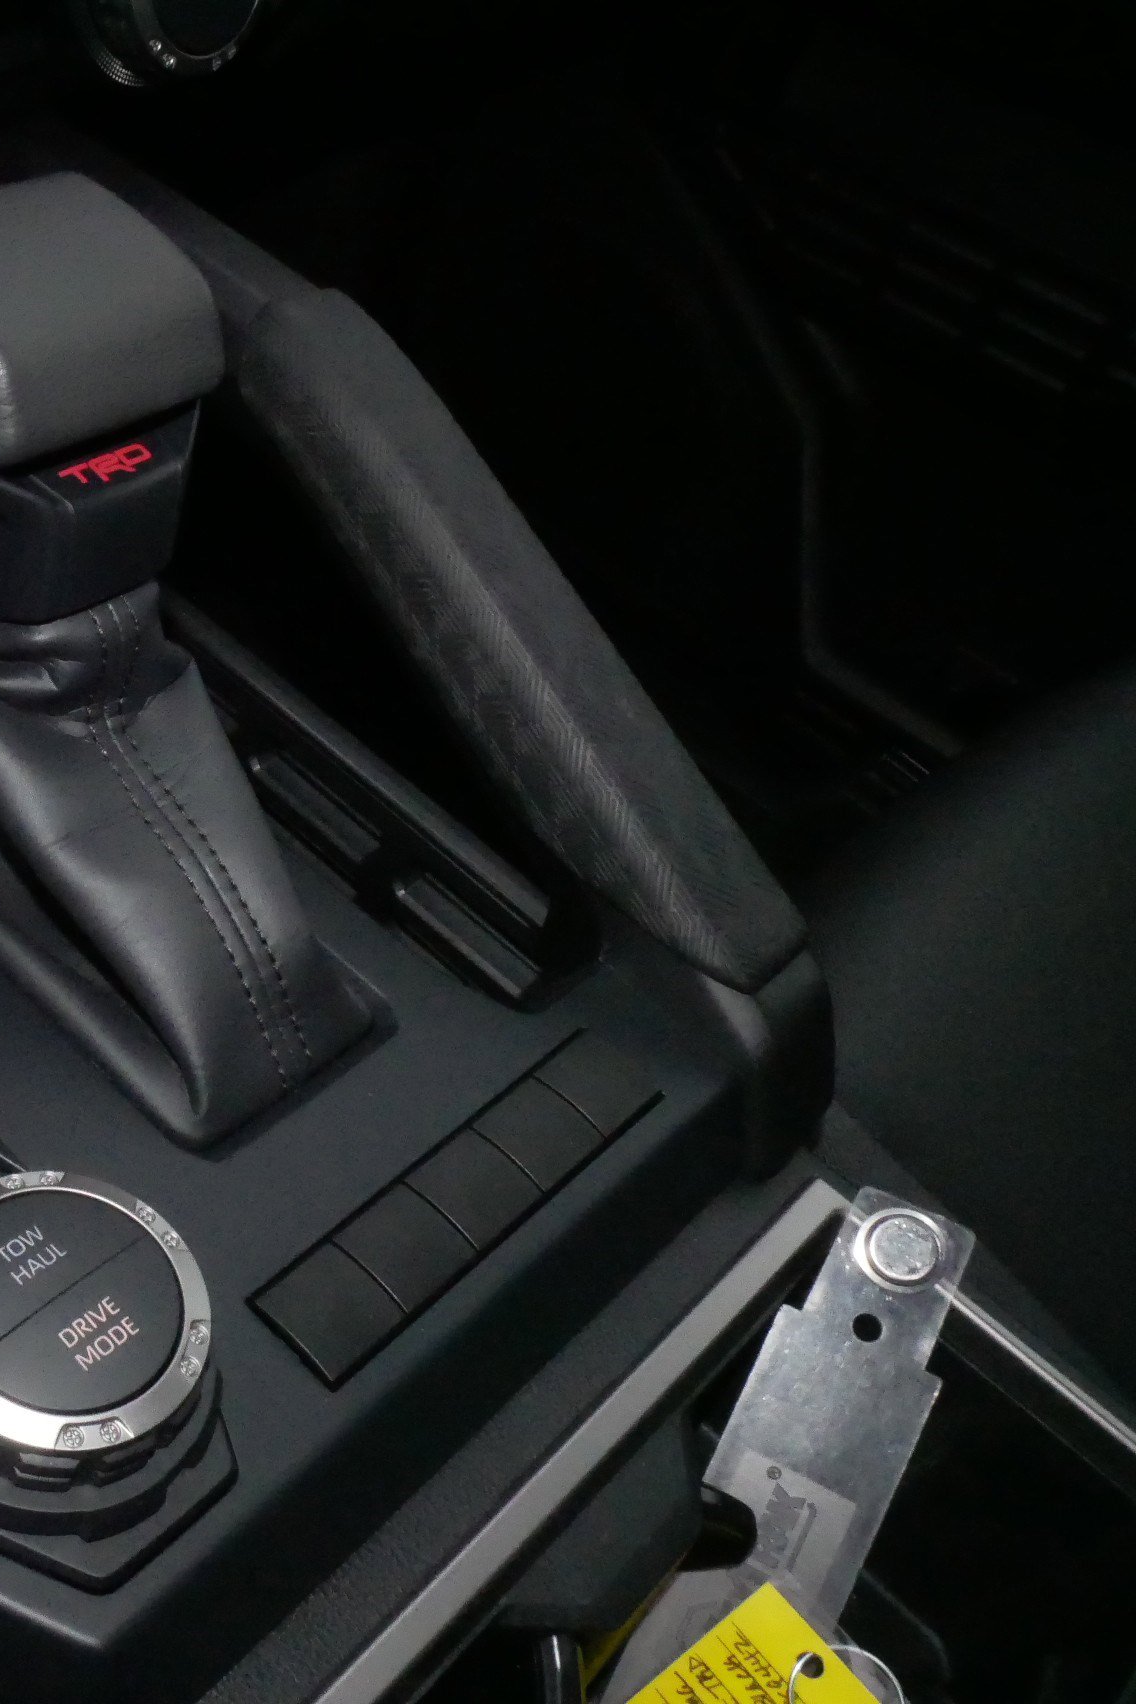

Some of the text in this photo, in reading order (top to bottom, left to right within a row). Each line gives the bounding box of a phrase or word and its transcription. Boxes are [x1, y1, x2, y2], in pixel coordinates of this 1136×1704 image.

[57, 443, 153, 484] TRD
[10, 1242, 68, 1286] HAUL
[57, 1295, 122, 1350] DRIVE
[73, 1315, 141, 1372] MODE
